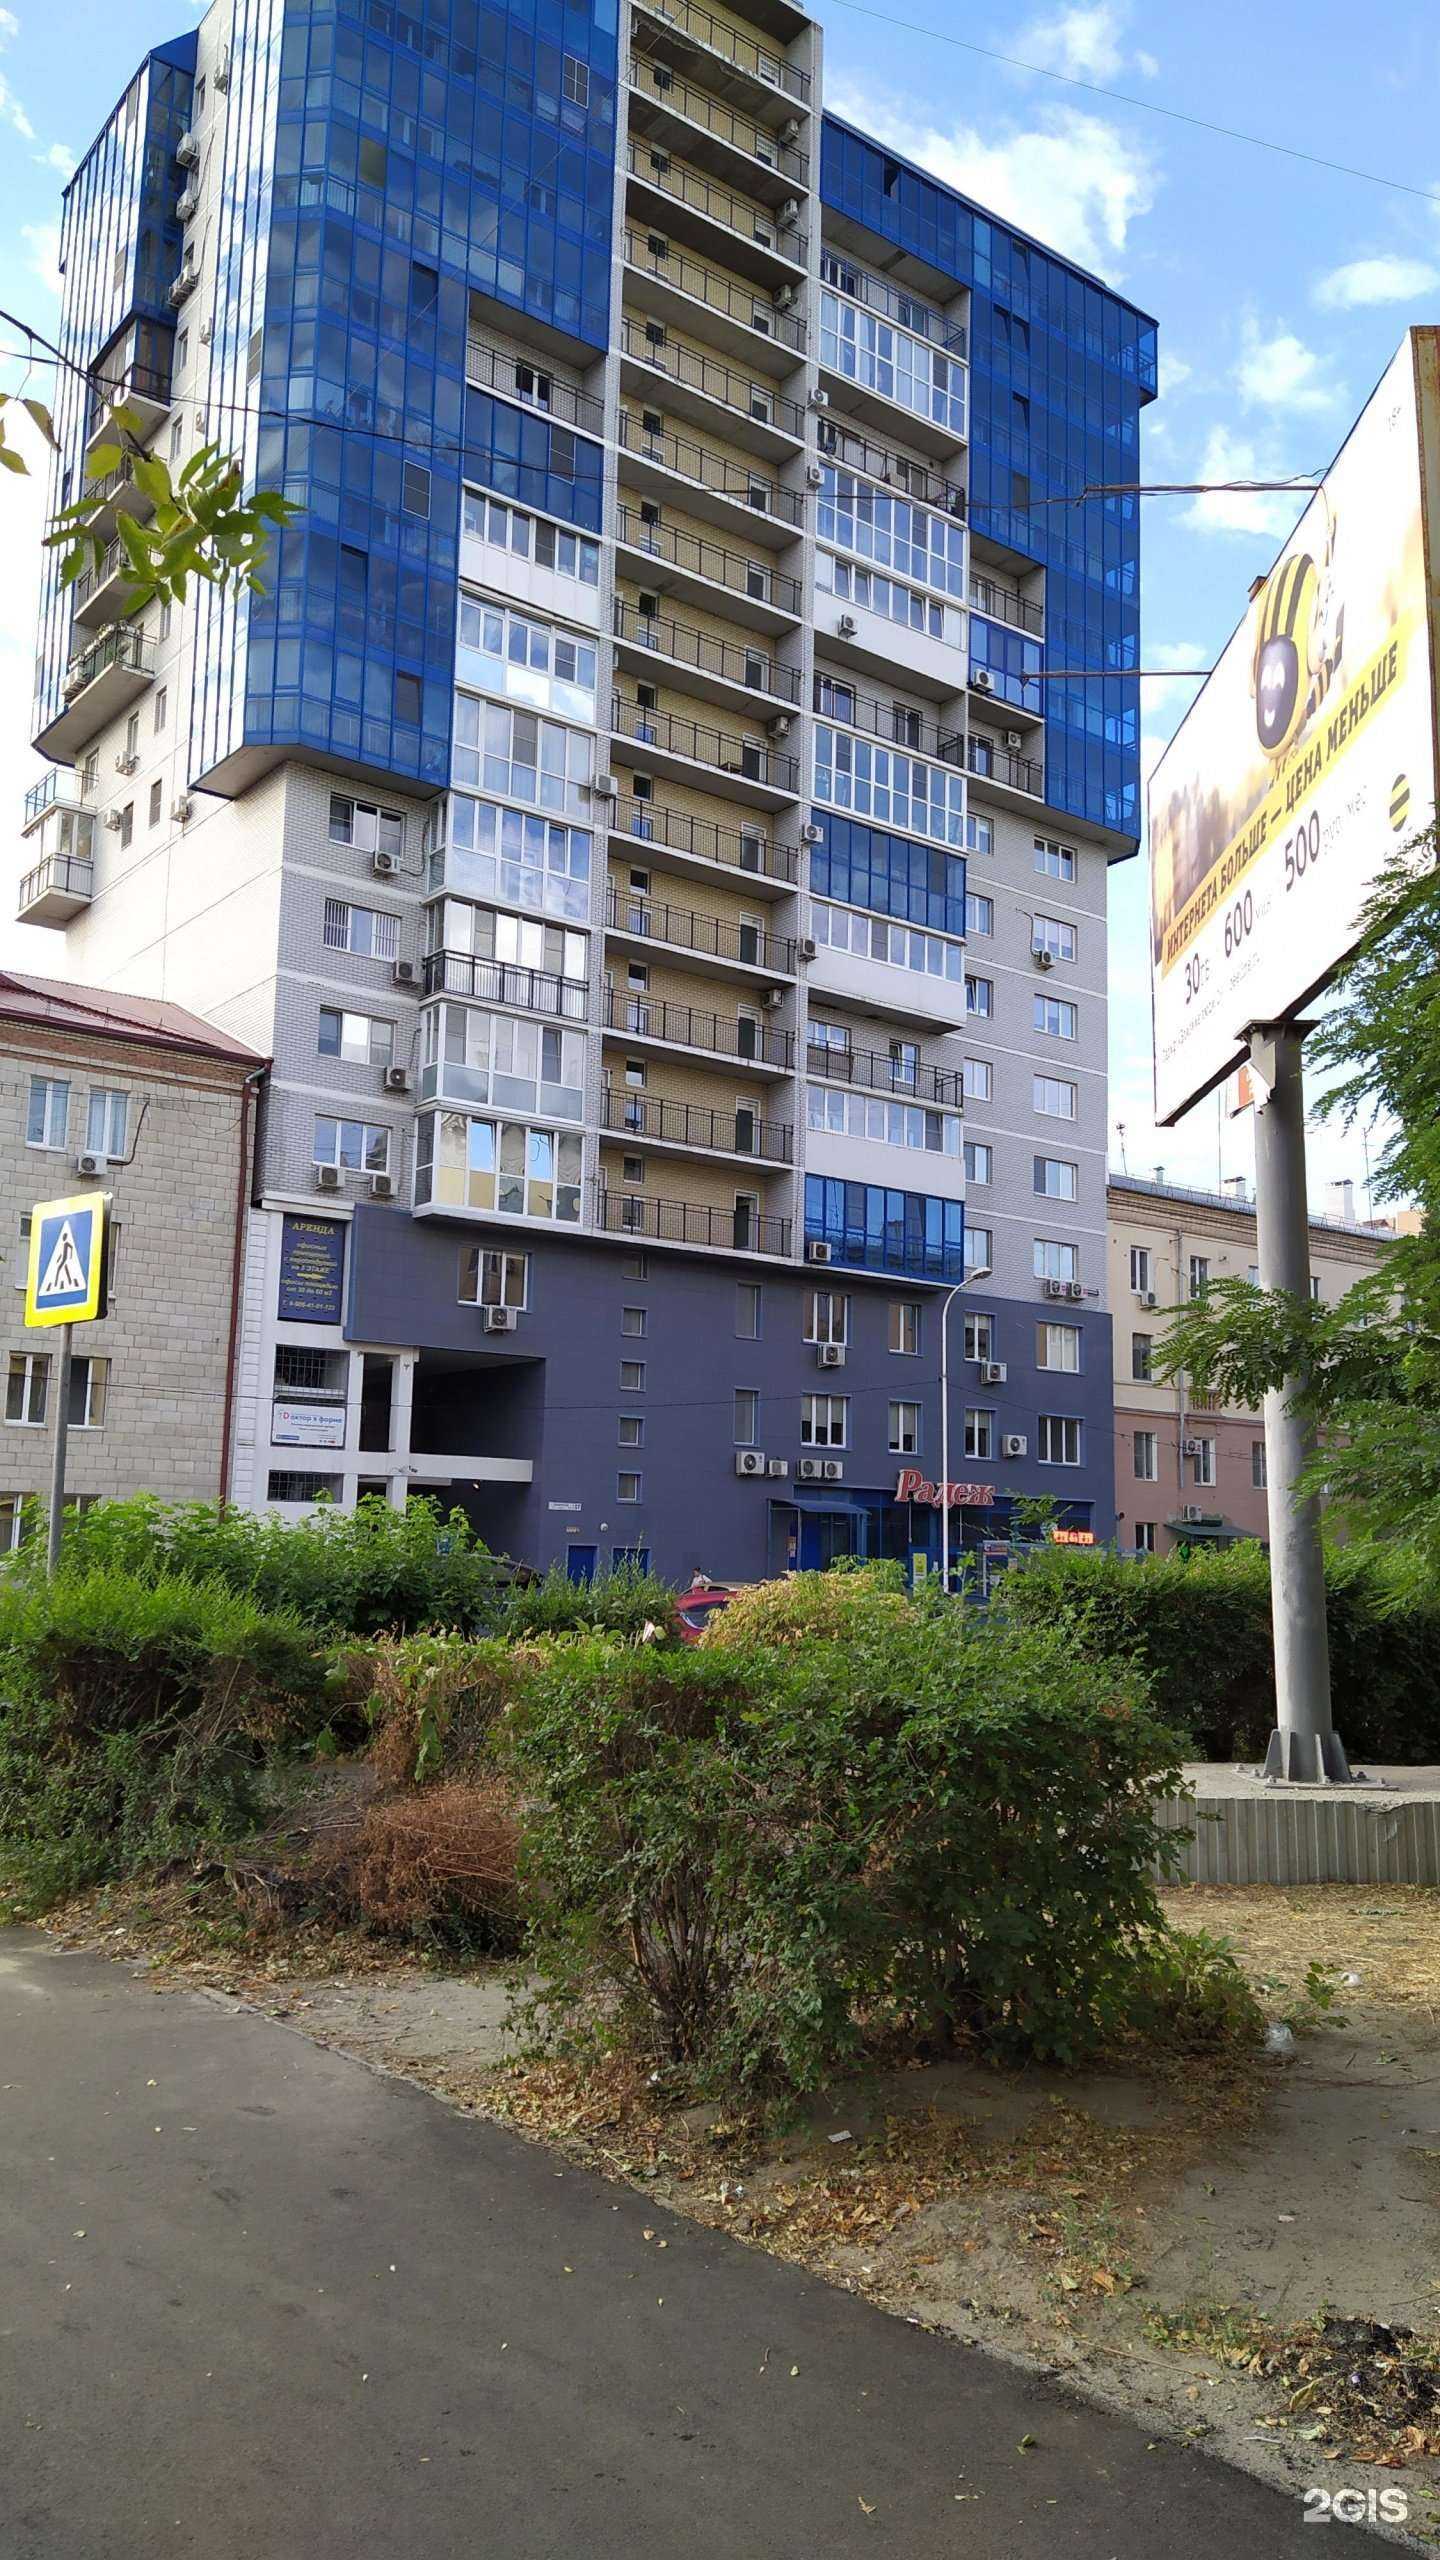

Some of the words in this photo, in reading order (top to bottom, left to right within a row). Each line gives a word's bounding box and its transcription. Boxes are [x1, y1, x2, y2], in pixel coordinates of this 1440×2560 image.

[1167, 880, 1217, 964] ИНТЕРНЕТА
[1220, 809, 1267, 894] БОЛЬШЕ
[1286, 748, 1322, 813] ЦЕНА
[1326, 639, 1399, 761] МЕНЬШЕ
[1285, 809, 1320, 892] 500
[1224, 889, 1252, 958] 600
[1184, 952, 1200, 1004] 30
[292, 1222, 336, 1236] АРЕНДА
